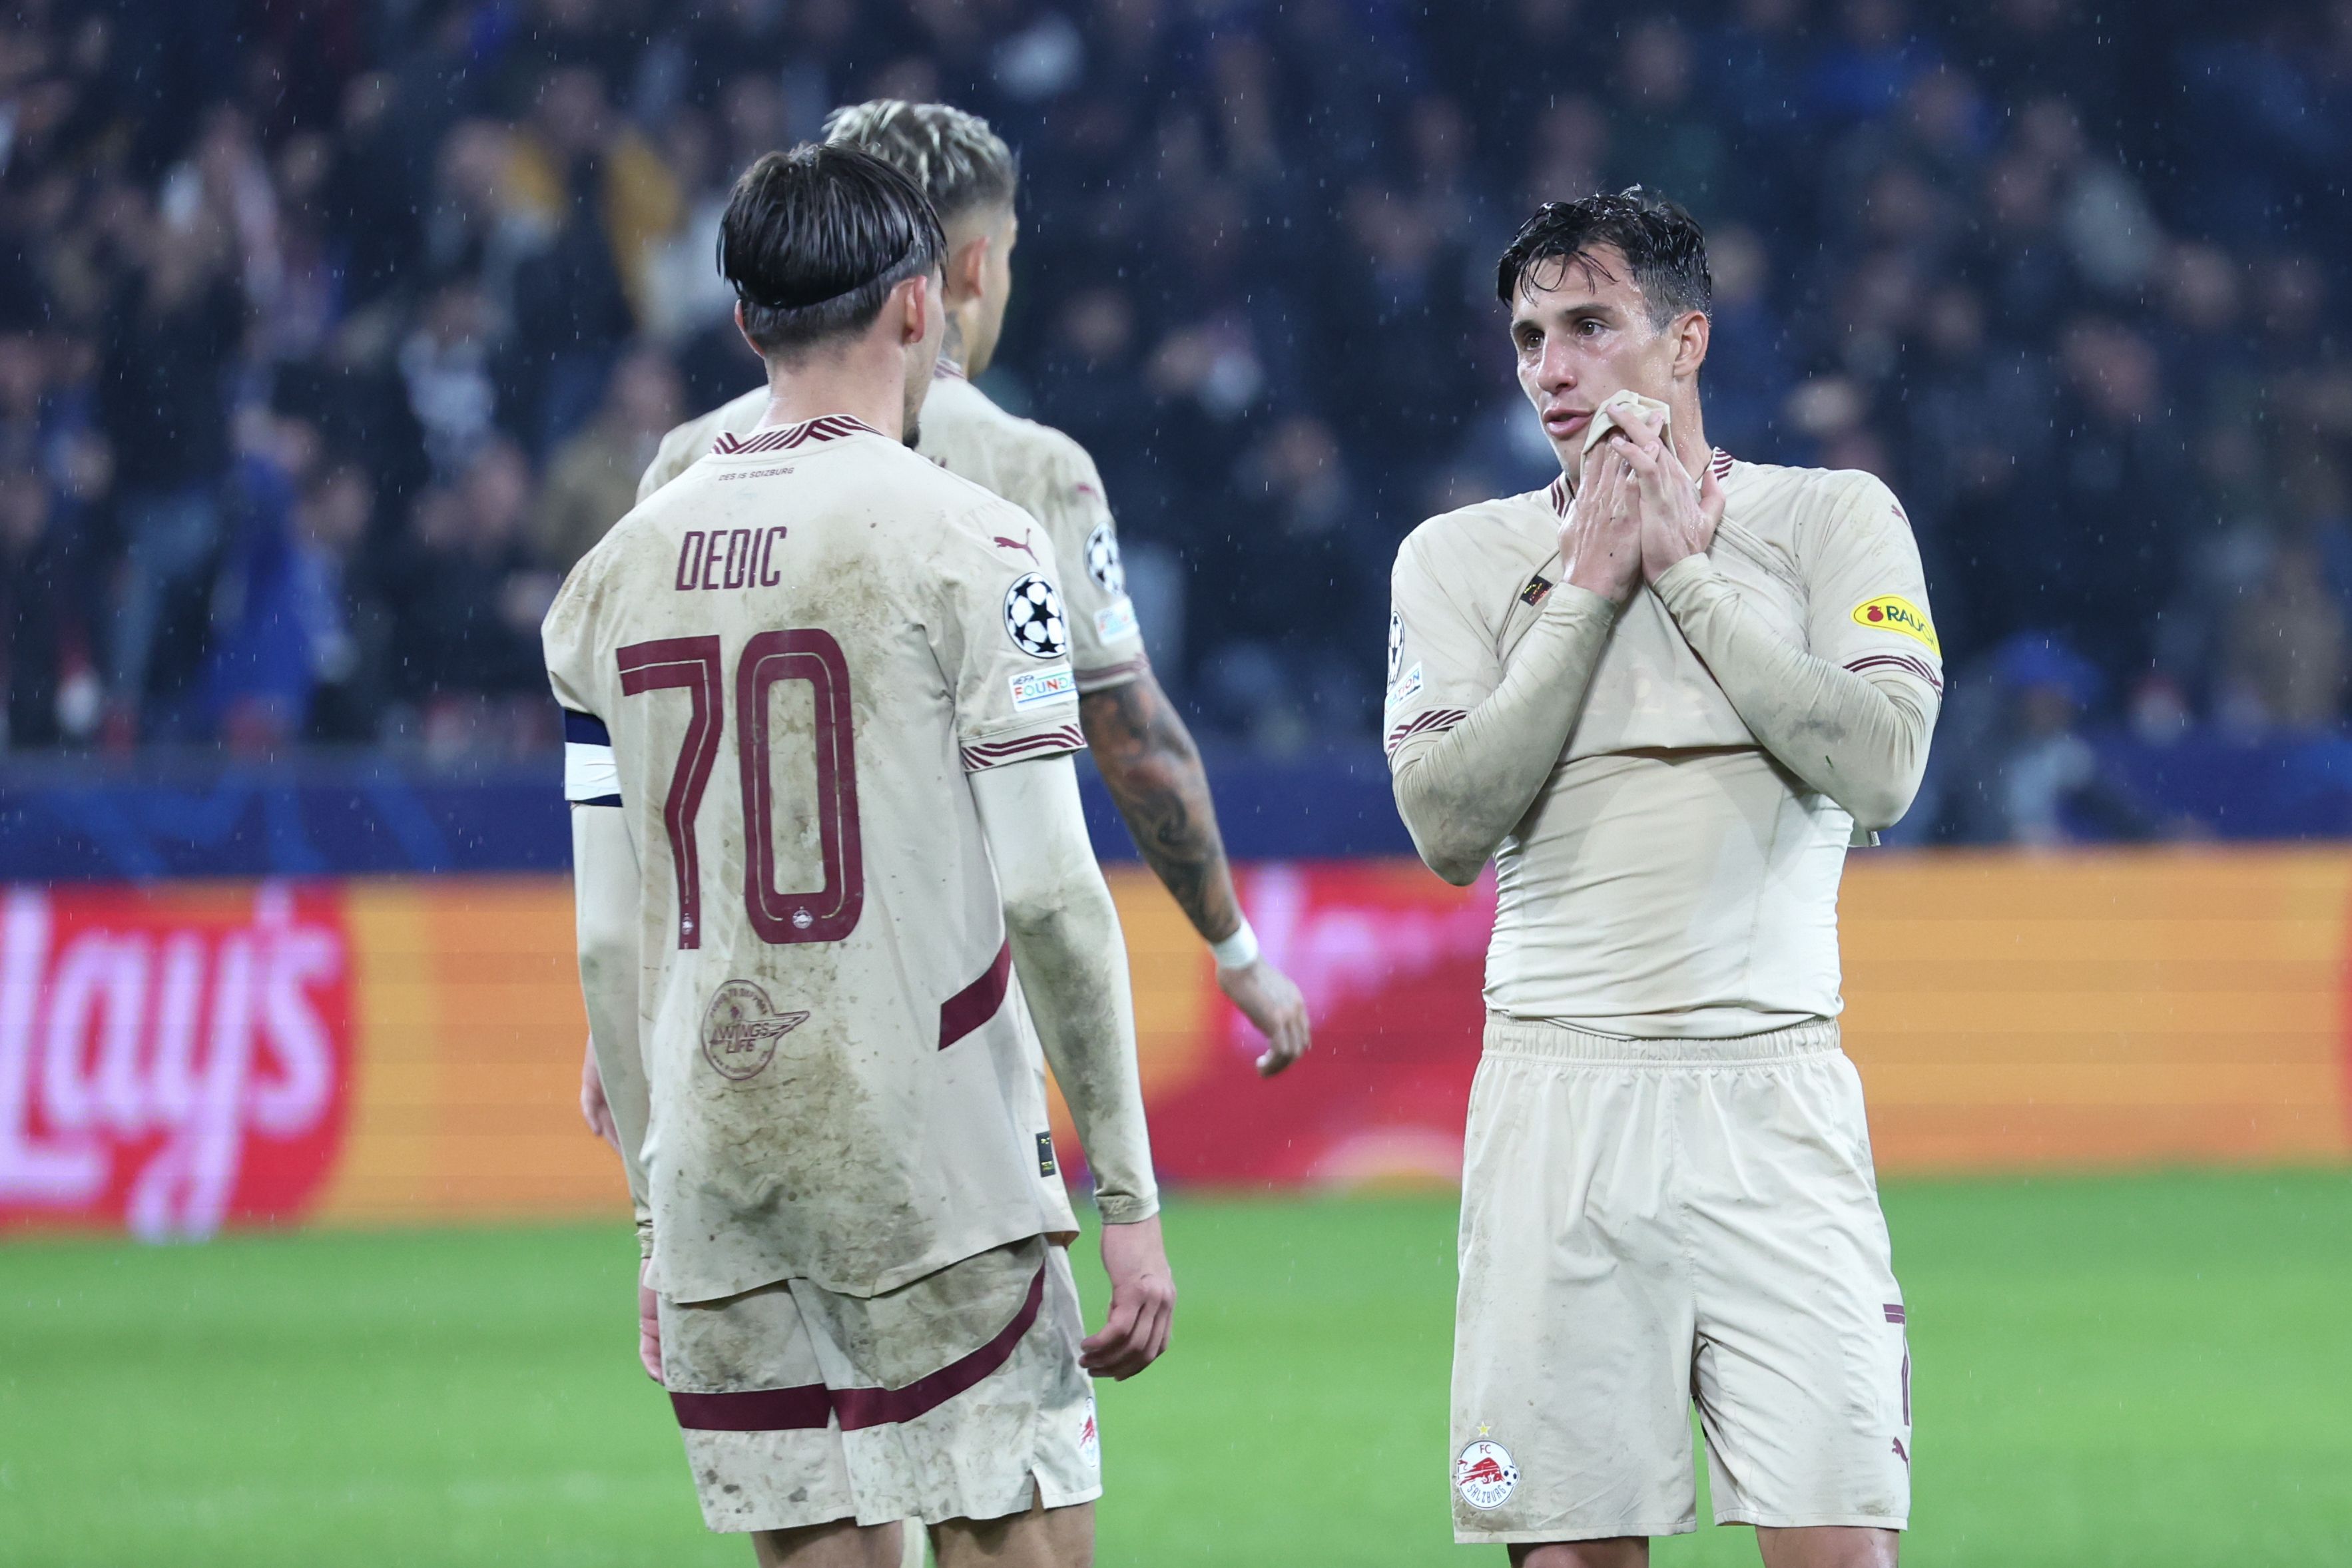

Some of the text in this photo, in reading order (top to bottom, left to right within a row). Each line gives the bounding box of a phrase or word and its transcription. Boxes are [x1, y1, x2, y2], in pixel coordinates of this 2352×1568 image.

[675, 526, 787, 591] DEDIC
[616, 629, 864, 949] 70
[713, 1022, 769, 1039] WINGS
[1480, 1443, 1492, 1454] FC
[1467, 1483, 1506, 1503] SALZBURG
